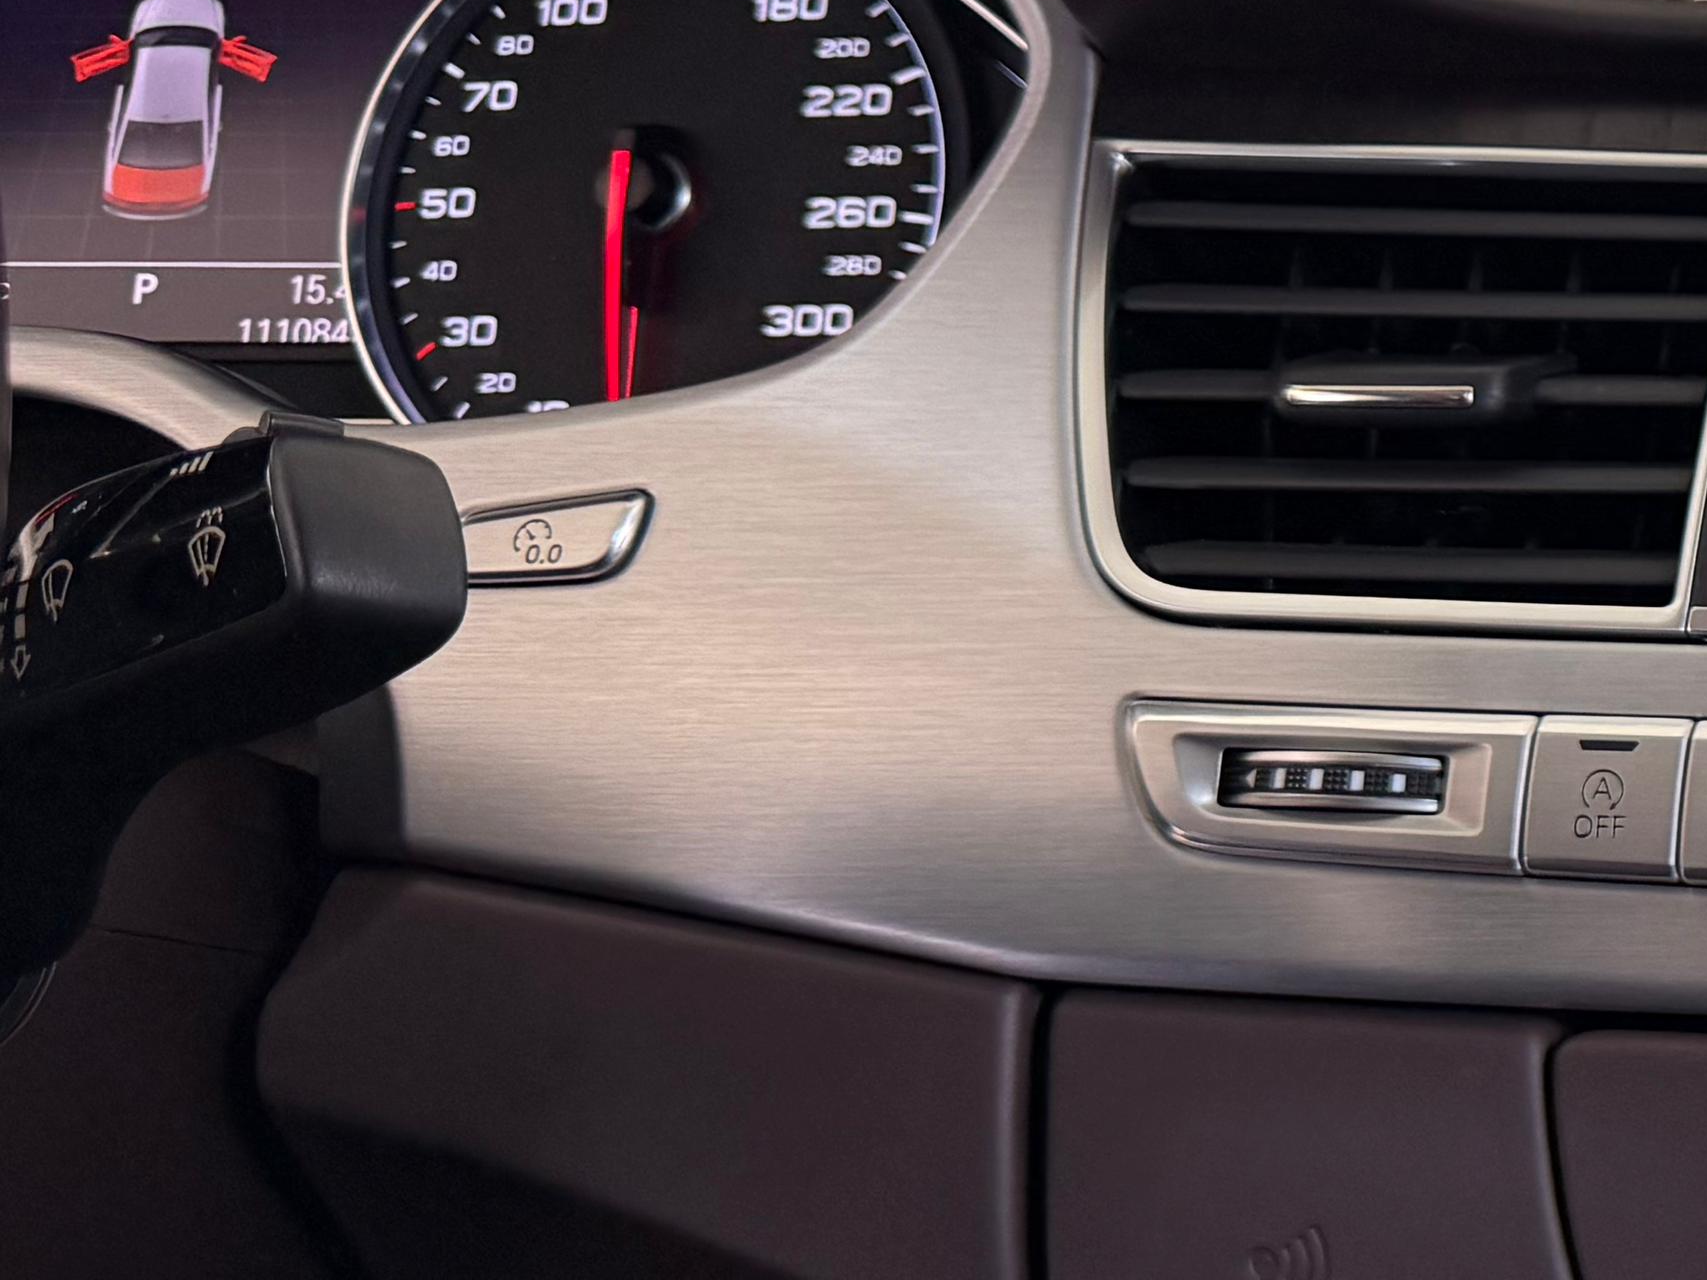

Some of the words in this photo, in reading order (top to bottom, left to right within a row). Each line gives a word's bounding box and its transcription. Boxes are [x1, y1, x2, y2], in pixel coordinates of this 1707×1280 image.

[496, 36, 534, 56] 80
[815, 38, 870, 58] 200
[464, 81, 518, 111] 70
[801, 86, 892, 117] 220
[433, 136, 470, 156] 60
[848, 146, 901, 166] 240
[418, 187, 476, 218] 50
[804, 198, 896, 229] 260
[421, 261, 457, 281] 40
[824, 255, 882, 276] 280
[131, 272, 159, 305] P
[441, 316, 498, 347] 30
[762, 304, 854, 336] 300
[476, 373, 517, 394] 20
[525, 544, 562, 564] 0.0
[1573, 815, 1626, 841] OFF
